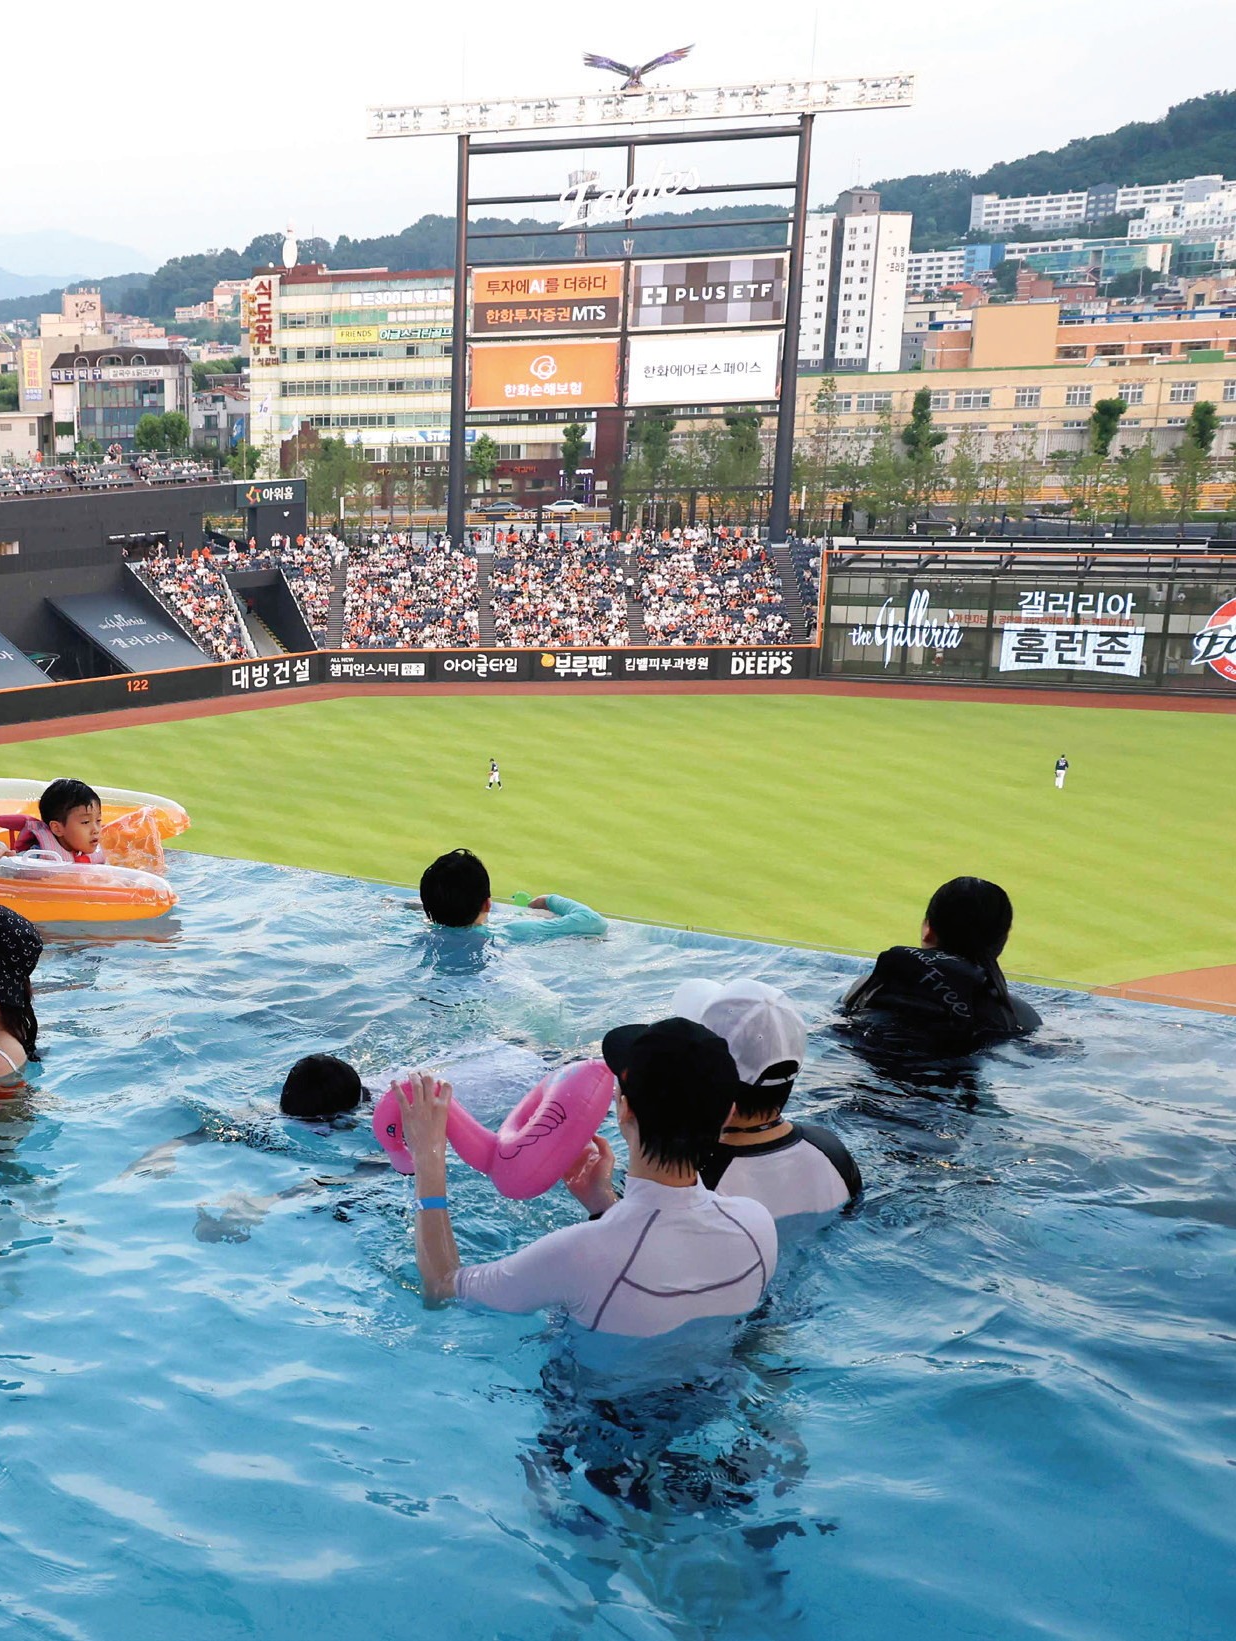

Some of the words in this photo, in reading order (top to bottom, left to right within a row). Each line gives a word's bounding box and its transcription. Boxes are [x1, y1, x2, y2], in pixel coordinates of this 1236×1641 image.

[558, 158, 701, 231] Eagles
[486, 277, 560, 296] 투자에AI를
[563, 275, 608, 293] 더하다
[675, 285, 726, 302] PLUS
[732, 283, 773, 299] ETF
[255, 279, 272, 345] 식도원
[340, 329, 372, 338] FRIENDS
[643, 361, 762, 379] 한화에어로스페이스
[504, 381, 583, 398] 한화손해보험
[262, 485, 294, 501] 아워홈
[1017, 590, 1137, 620] 갤러리아
[105, 614, 147, 633] Galleria
[848, 622, 874, 646] the
[874, 588, 964, 669] Galleria
[111, 631, 175, 649] 갤러리아
[1011, 628, 1131, 667] 홈런존
[231, 657, 311, 690] 대방건설
[329, 662, 399, 678] 챔피언스시티
[554, 655, 607, 677] 부루펜
[624, 656, 709, 672] 킴벨피부과병원
[730, 656, 793, 675] DEEPS
[126, 679, 149, 692] 122
[904, 946, 936, 966] And
[918, 966, 971, 1018] Free
